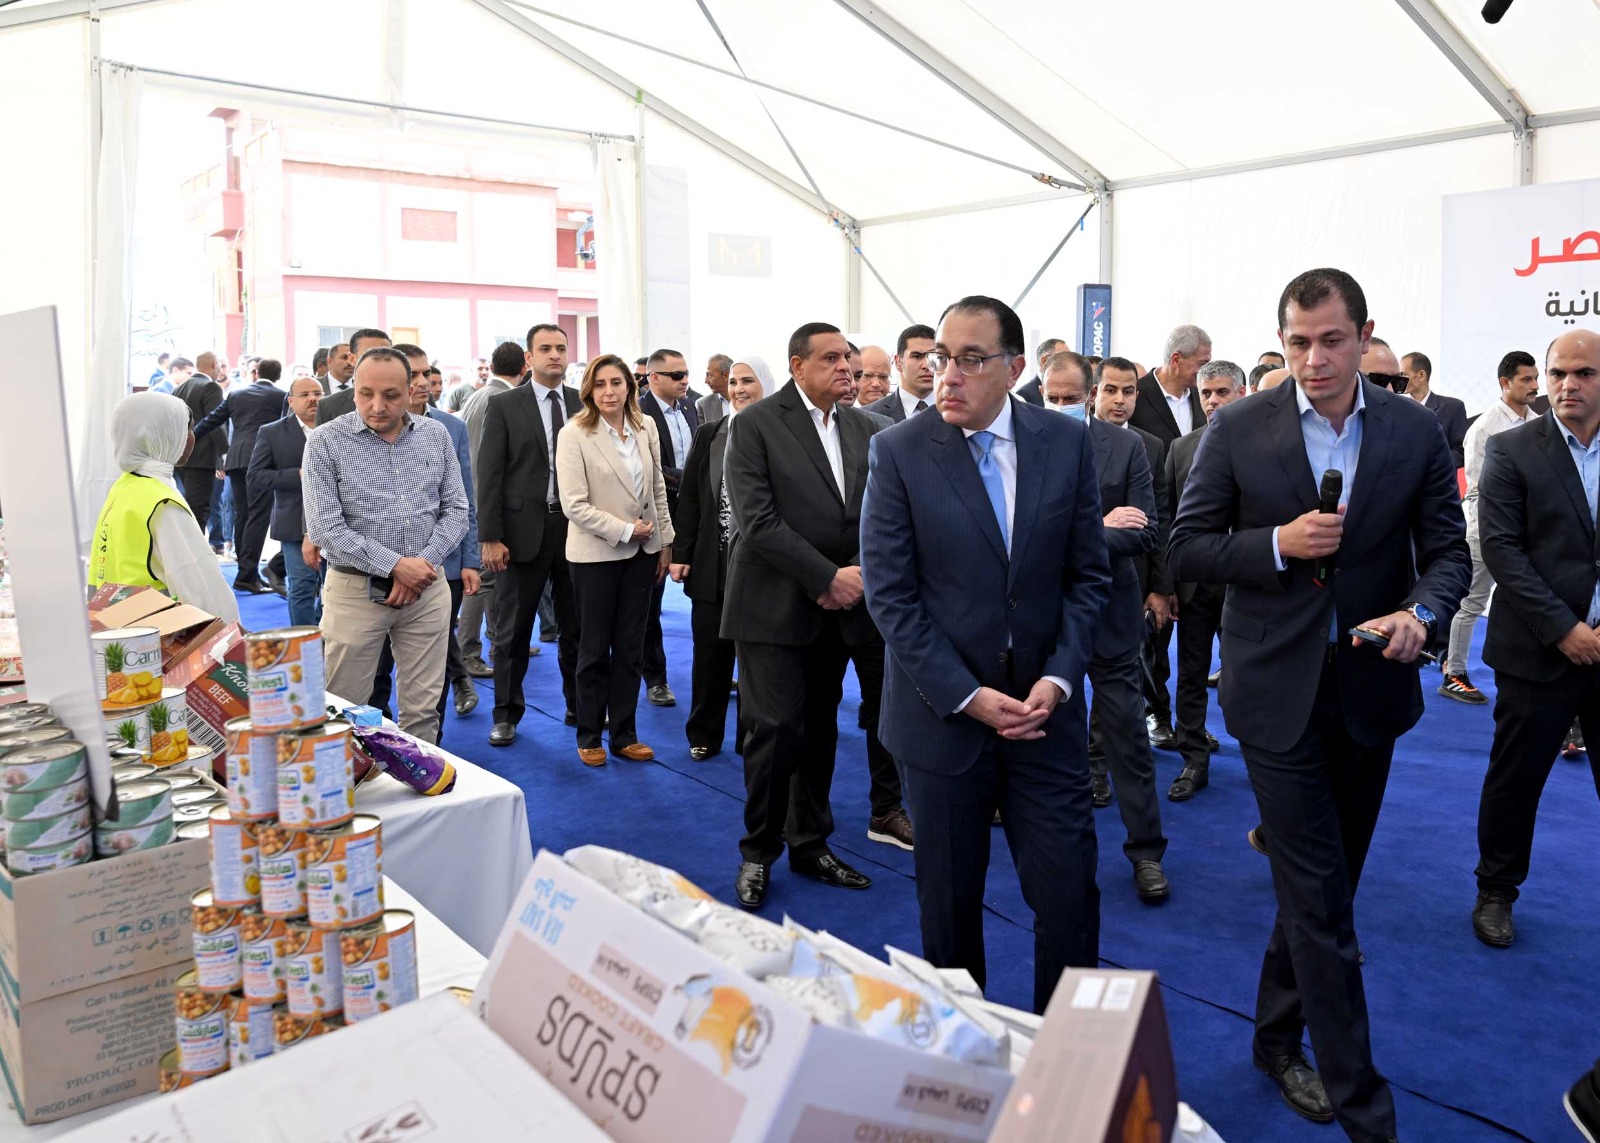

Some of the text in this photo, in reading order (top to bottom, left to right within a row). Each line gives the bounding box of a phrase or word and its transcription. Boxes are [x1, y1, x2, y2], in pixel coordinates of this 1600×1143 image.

[1514, 230, 1600, 278] صر
[1545, 289, 1600, 325] انية
[208, 683, 234, 709] BEEF
[85, 996, 107, 1008] Can
[109, 984, 151, 1001] Number
[66, 1060, 135, 1090] PRODUCT
[137, 1054, 156, 1068] OF
[536, 994, 663, 1122] SPUDS
[35, 1101, 66, 1117] PROD
[68, 1091, 94, 1107] DATE
